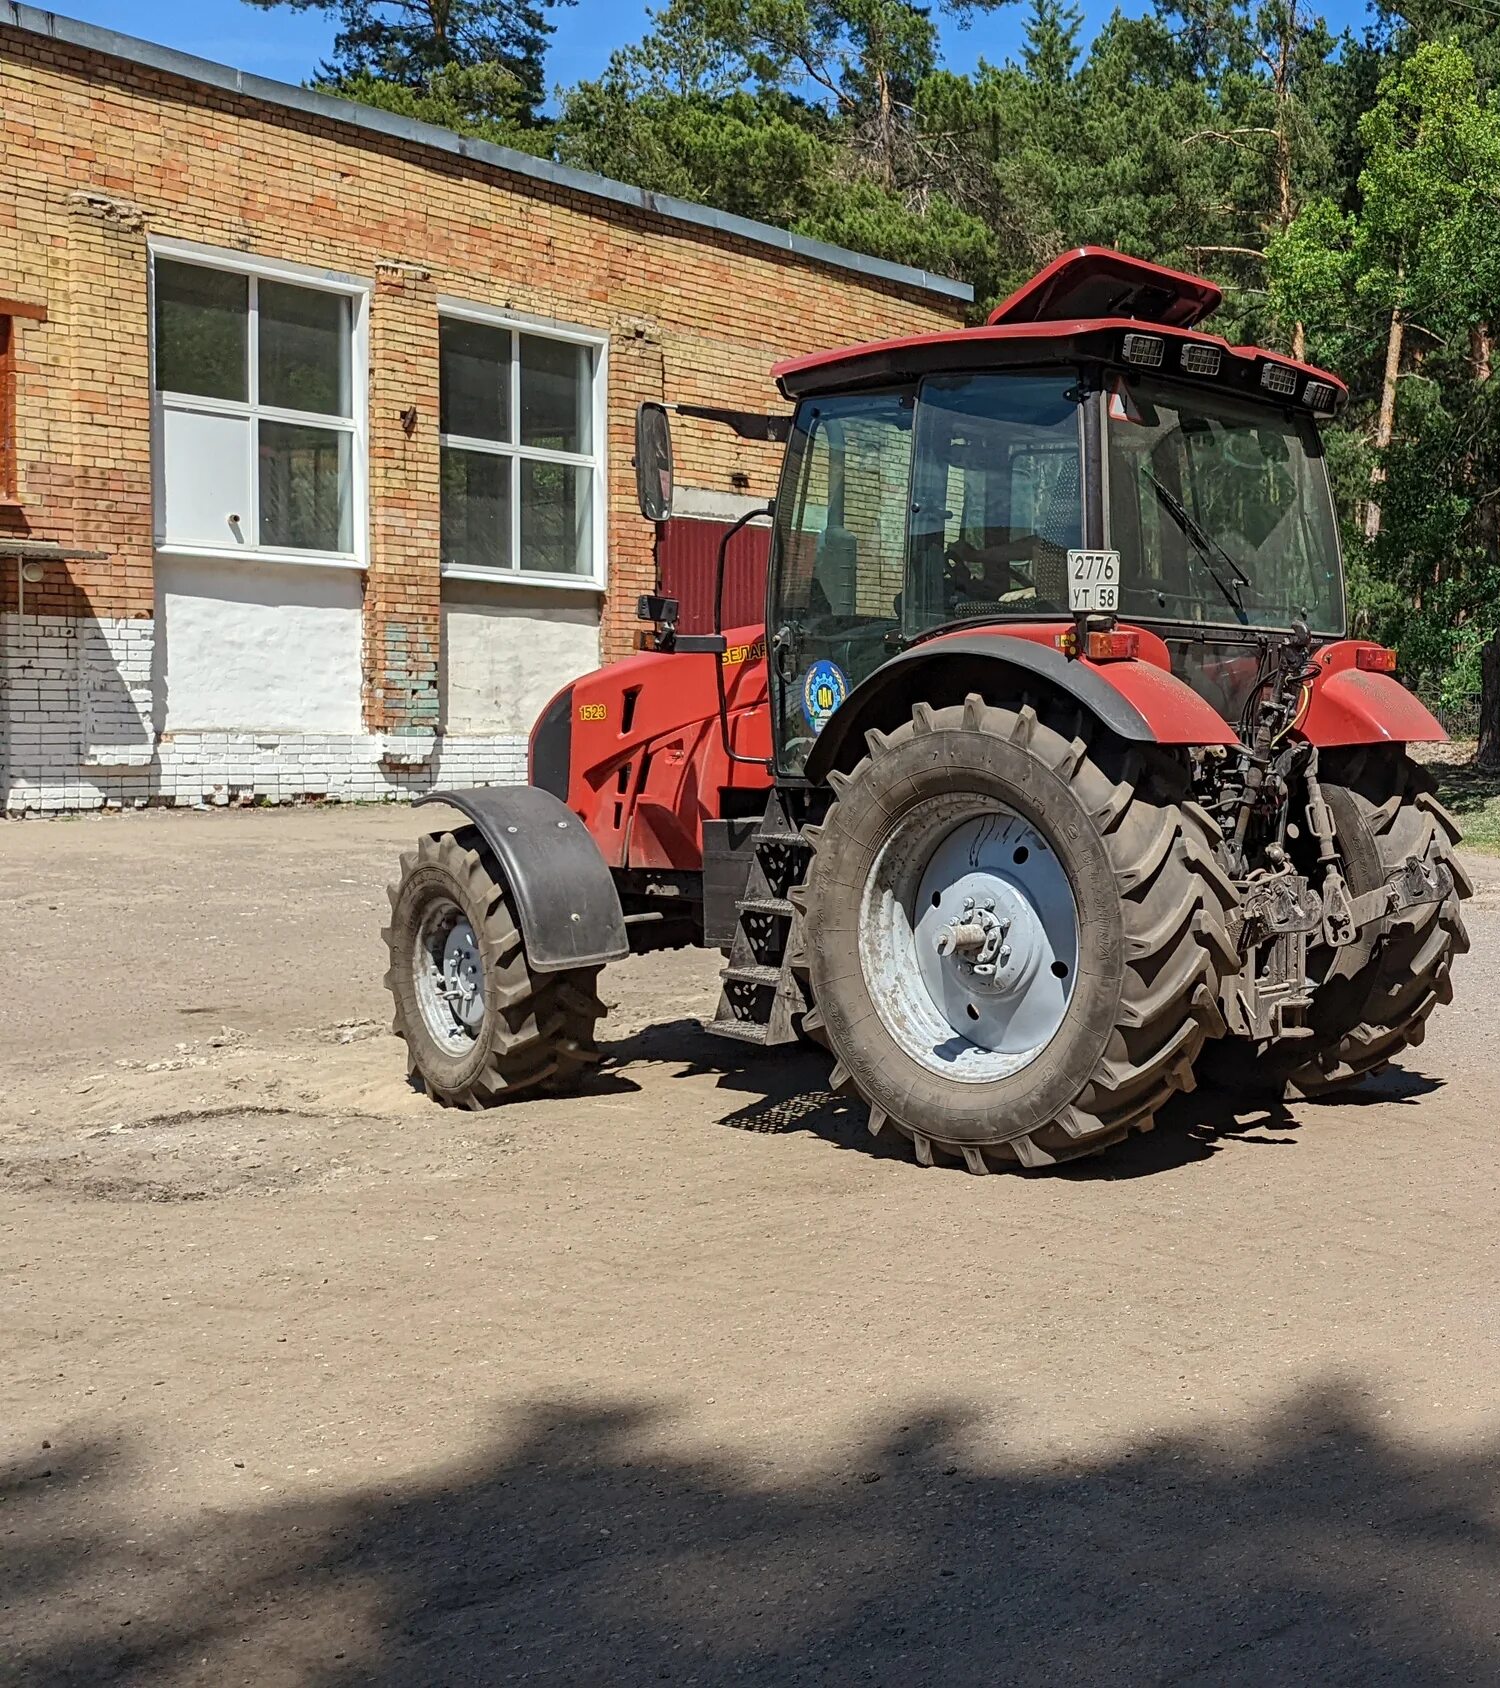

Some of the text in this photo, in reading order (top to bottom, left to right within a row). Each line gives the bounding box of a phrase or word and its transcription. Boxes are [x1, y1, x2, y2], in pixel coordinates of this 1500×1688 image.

[1074, 555, 1114, 580] 2776
[1073, 588, 1114, 608] УТ 58
[579, 704, 607, 720] 1523
